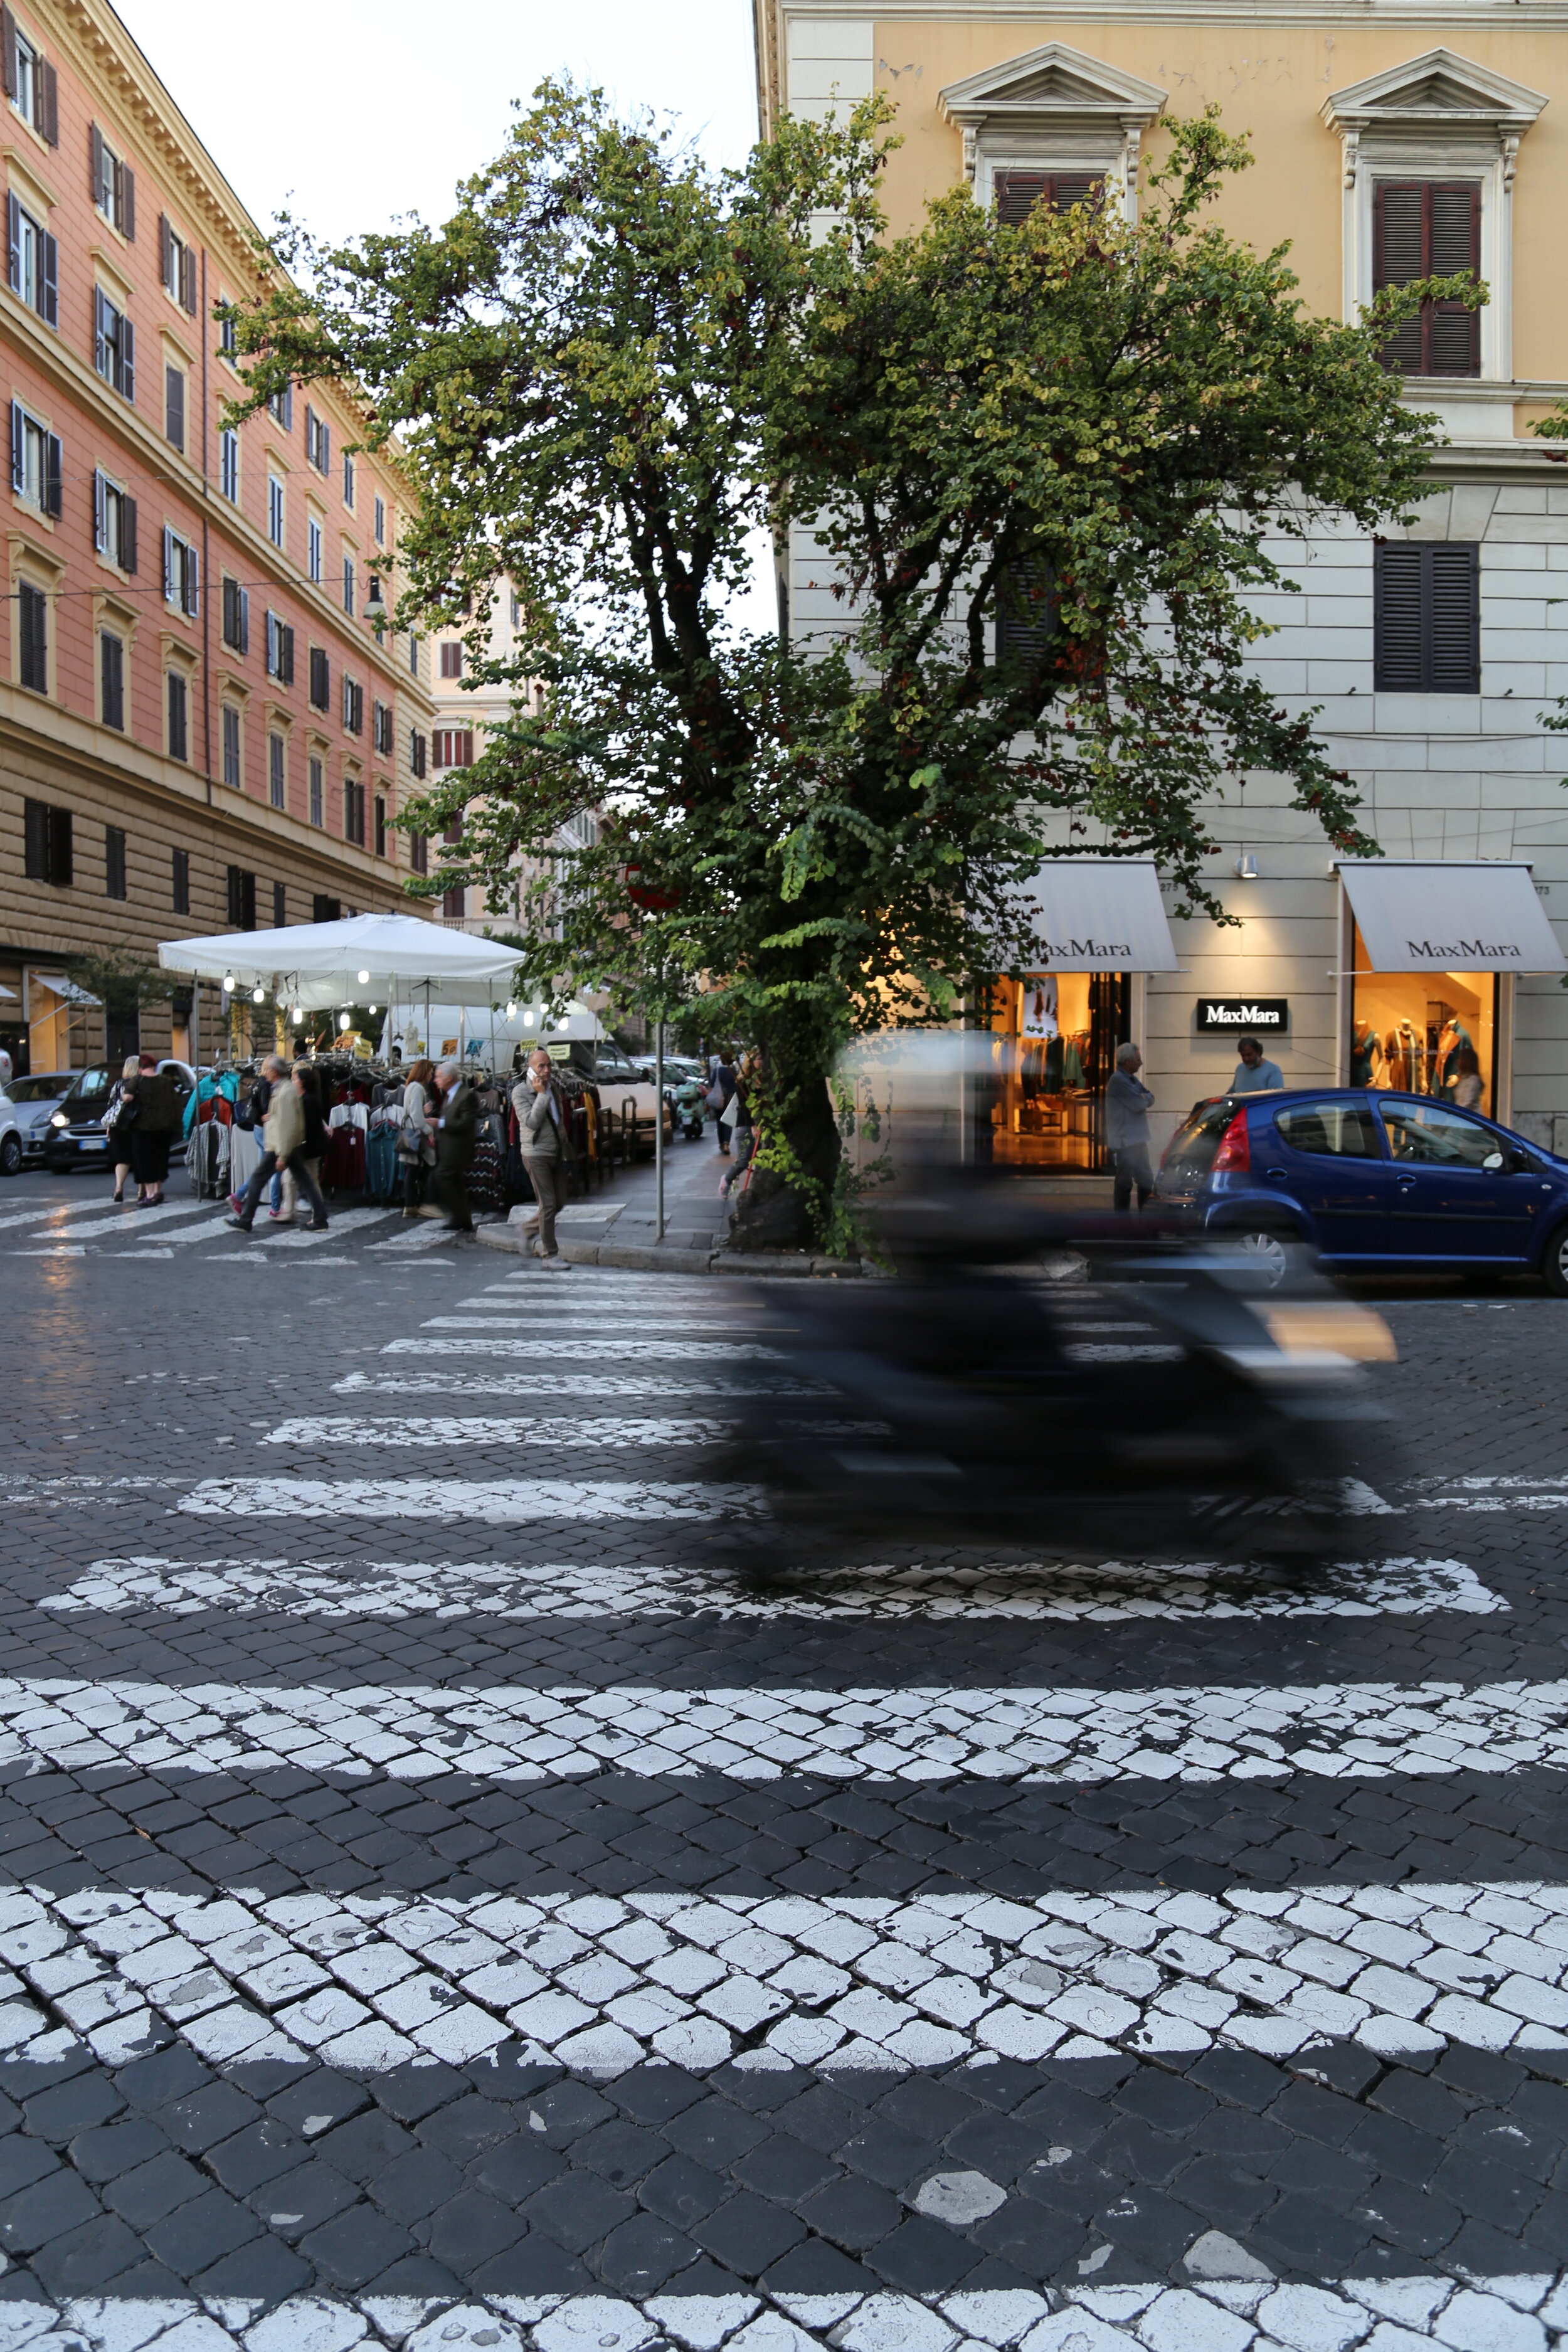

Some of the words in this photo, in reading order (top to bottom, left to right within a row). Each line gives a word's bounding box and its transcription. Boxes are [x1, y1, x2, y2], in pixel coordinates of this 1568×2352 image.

[1160, 882, 1179, 891] 275
[1405, 940, 1521, 957] MaxMara
[1205, 1005, 1280, 1023] MaxMara
